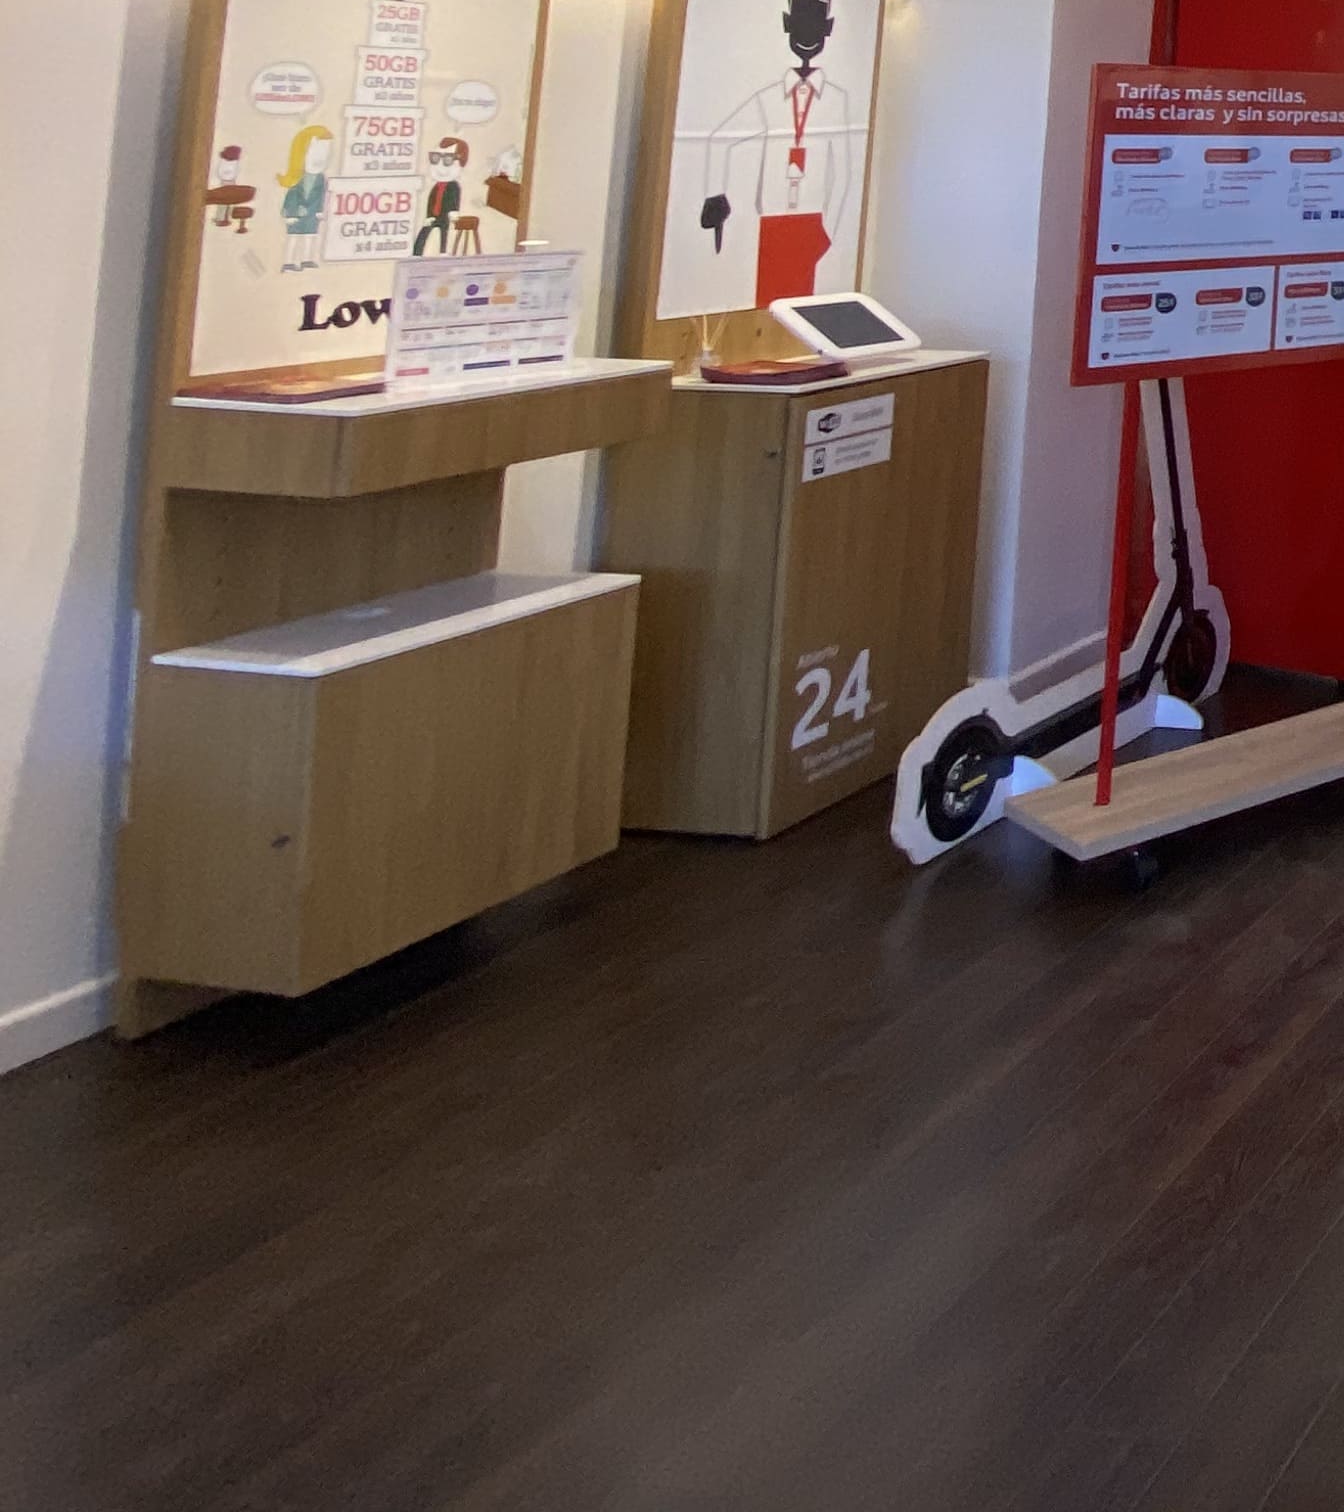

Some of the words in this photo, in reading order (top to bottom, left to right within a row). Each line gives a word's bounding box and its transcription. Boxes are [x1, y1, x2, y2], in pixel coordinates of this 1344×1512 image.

[377, 4, 420, 21] 25GB
[365, 54, 417, 72] 50GB
[363, 76, 416, 89] GRATIS
[1116, 82, 1180, 101] Tarifas
[1184, 86, 1223, 101] más
[1115, 103, 1155, 120] más
[1159, 104, 1215, 122] claras
[1222, 109, 1234, 125] y
[1237, 106, 1263, 122] sin
[353, 116, 416, 137] 75GB
[351, 142, 414, 157] GRATIS
[333, 191, 412, 216] 100GB
[340, 220, 410, 237] GRATIS
[355, 241, 373, 253] x4
[376, 238, 408, 252] años
[791, 648, 872, 751] 24
